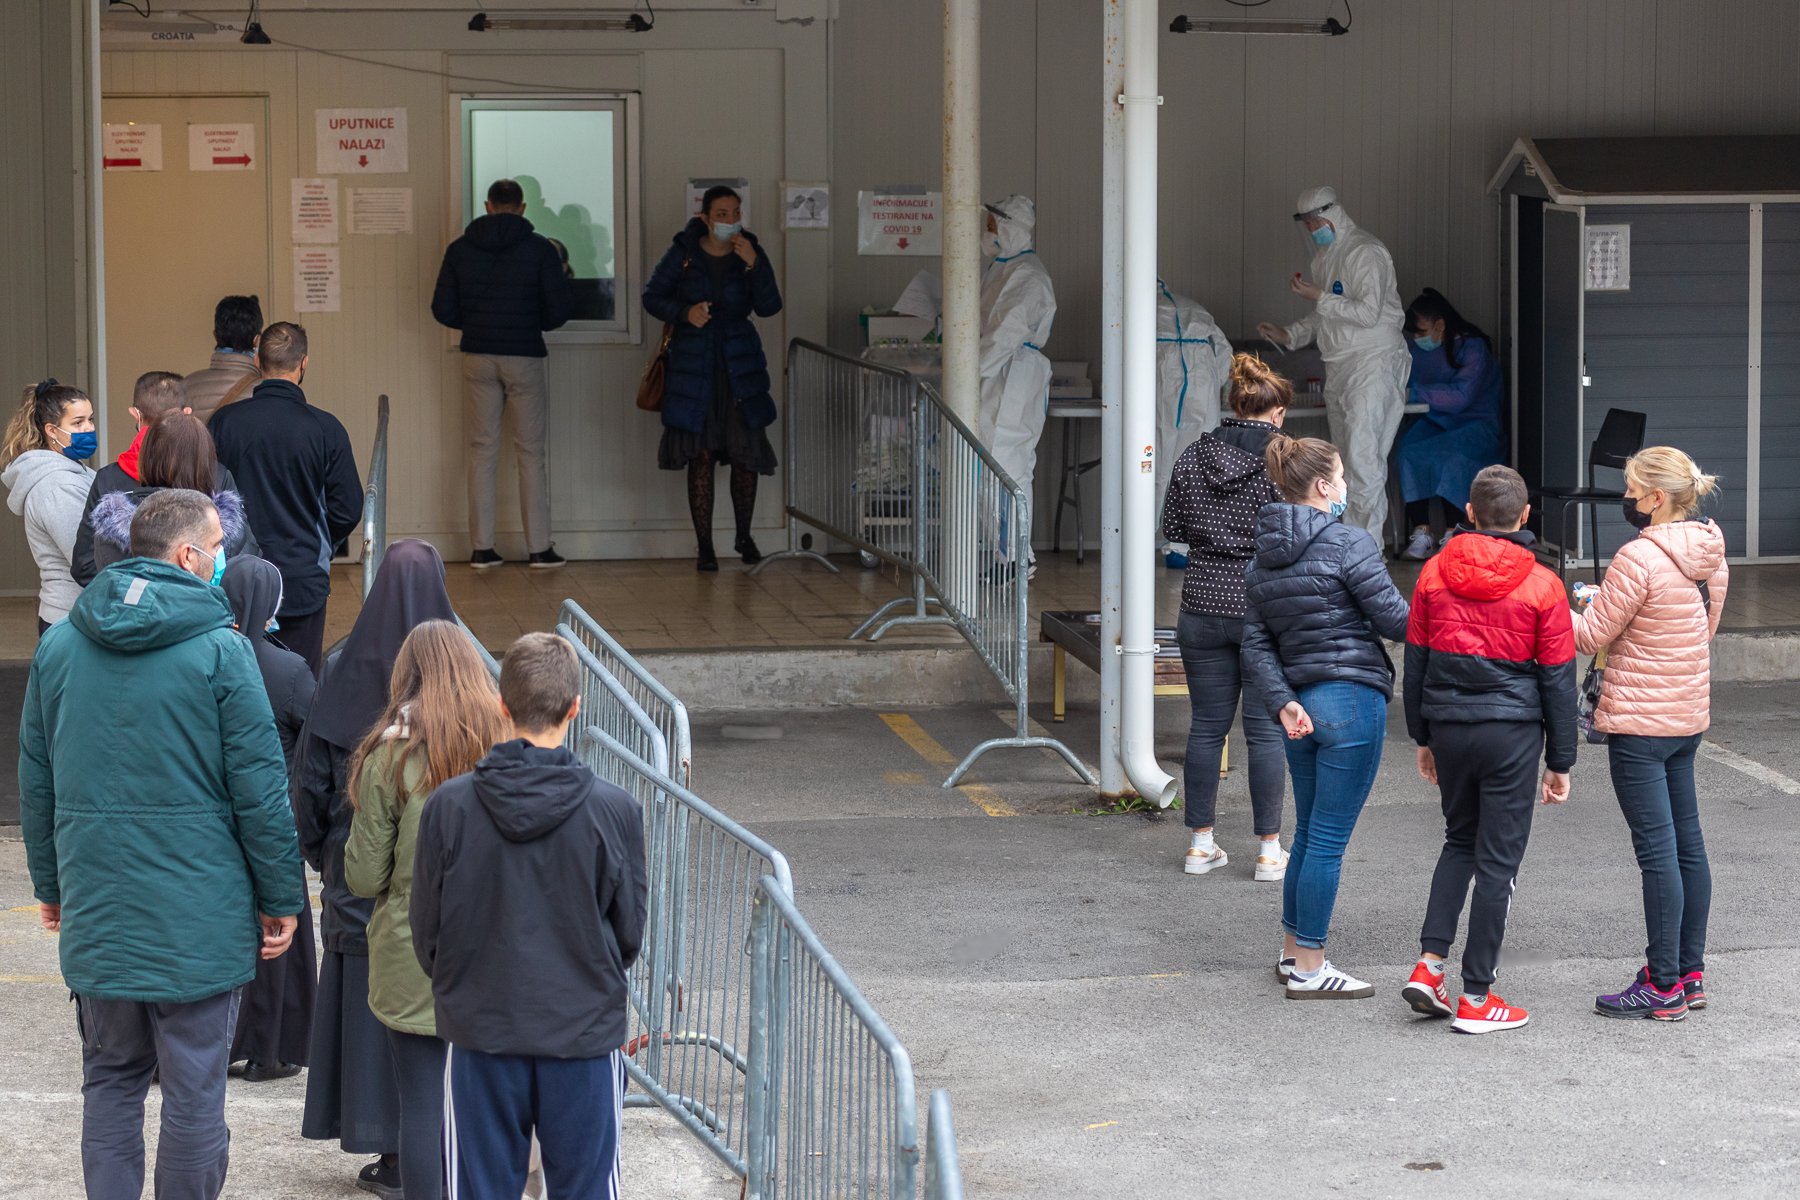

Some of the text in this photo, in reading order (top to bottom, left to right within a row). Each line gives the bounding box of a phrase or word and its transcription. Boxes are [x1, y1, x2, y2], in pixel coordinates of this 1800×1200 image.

[151, 32, 195, 41] CROATIA
[329, 117, 395, 130] UPUTNICE
[339, 138, 385, 150] NALAZI
[873, 199, 928, 207] INFORMACIJE
[872, 212, 934, 220] TESTIRANJE NA
[883, 225, 922, 234] COVID 19
